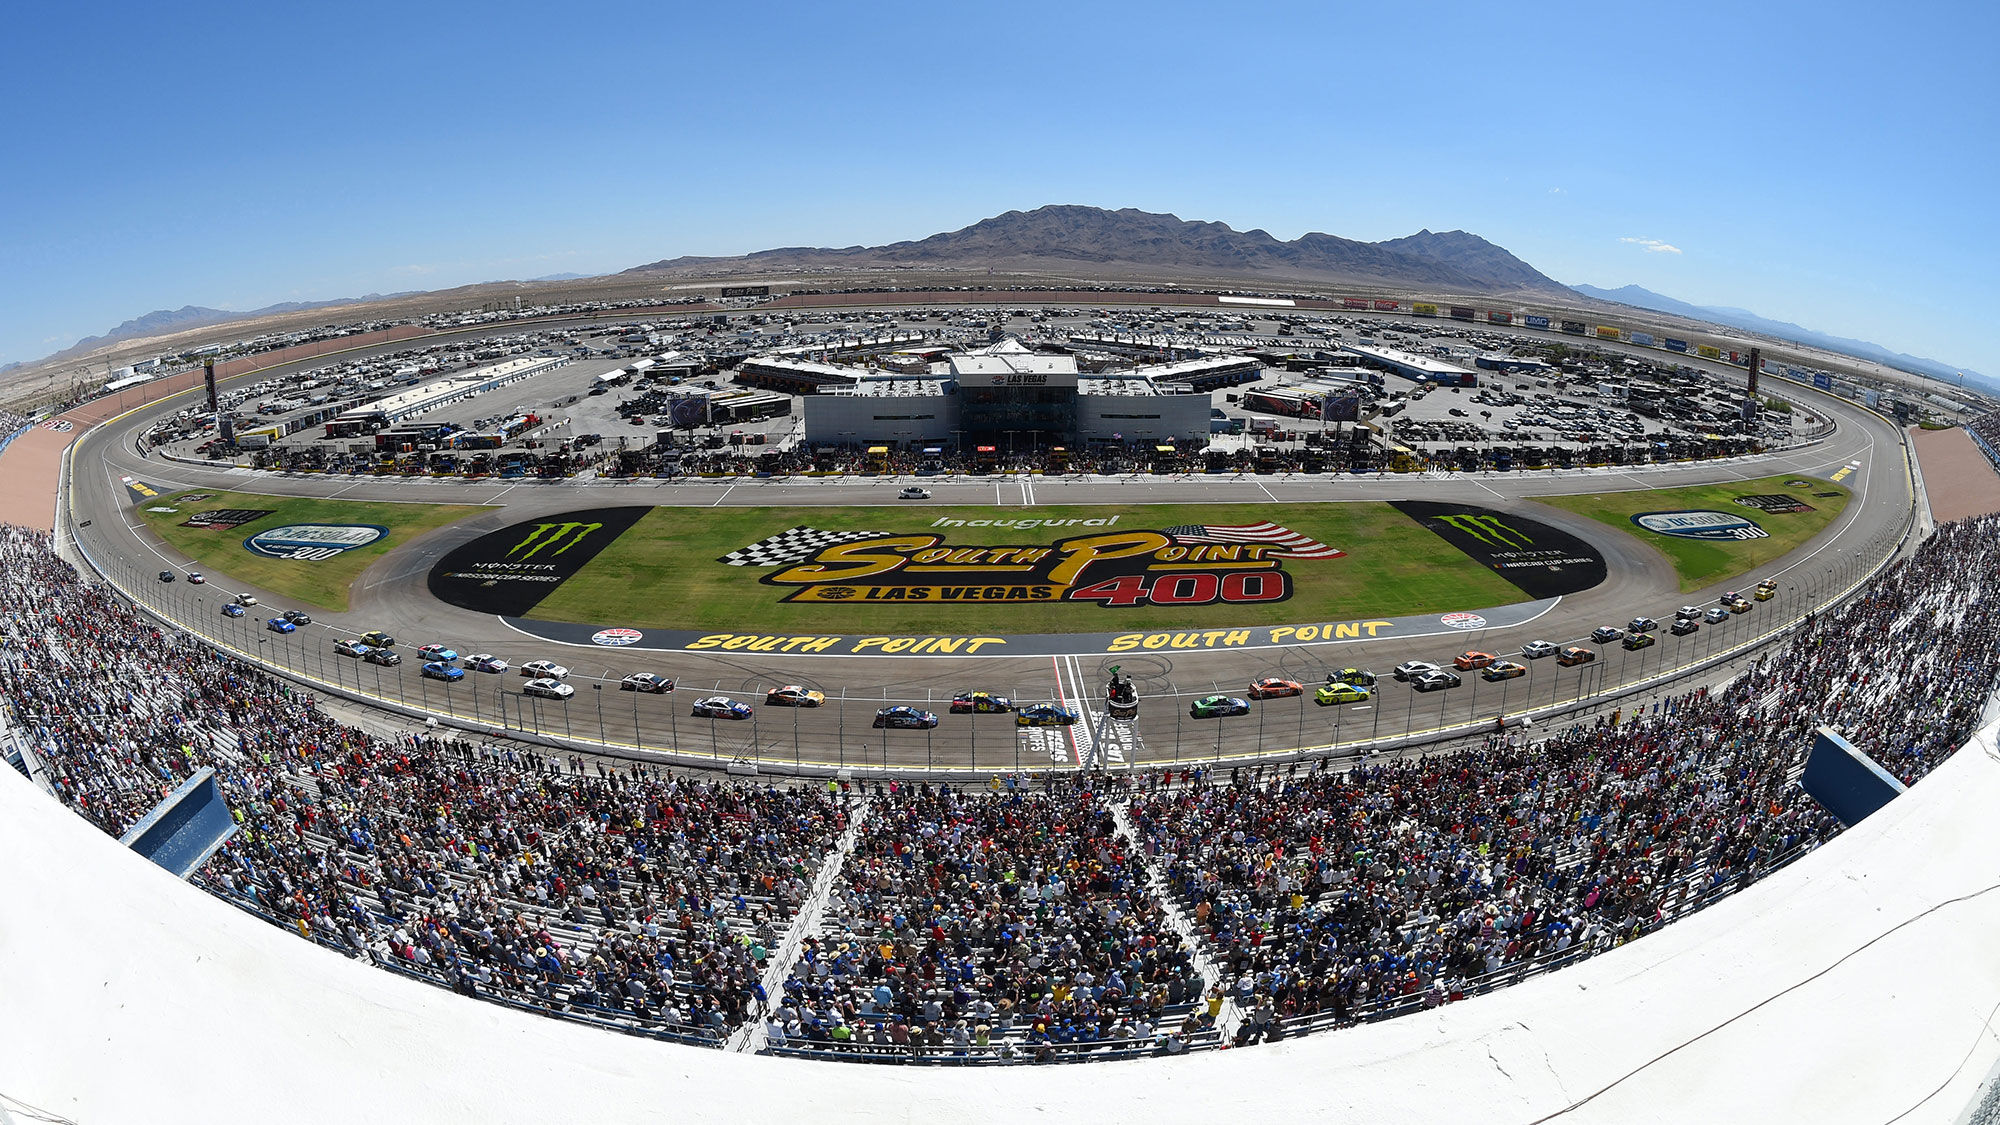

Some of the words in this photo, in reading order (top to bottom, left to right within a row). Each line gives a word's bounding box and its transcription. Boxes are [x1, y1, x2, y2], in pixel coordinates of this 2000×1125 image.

[1007, 375, 1022, 383] LAS
[1023, 375, 1048, 383] VEGAS
[930, 515, 1120, 530] Inaugural
[1725, 526, 1770, 540] 300
[280, 546, 344, 560] 300
[772, 533, 1053, 583] SOUTH
[1047, 532, 1288, 586] POINT
[1506, 560, 1544, 568] NASCAR
[865, 586, 930, 600] LAS
[941, 586, 1053, 600] VEGAS
[1070, 571, 1285, 605] 400
[1107, 629, 1251, 652] SOUTH
[1269, 621, 1395, 643] POINT
[685, 634, 843, 653] SOUTH
[850, 636, 1007, 654] POINT
